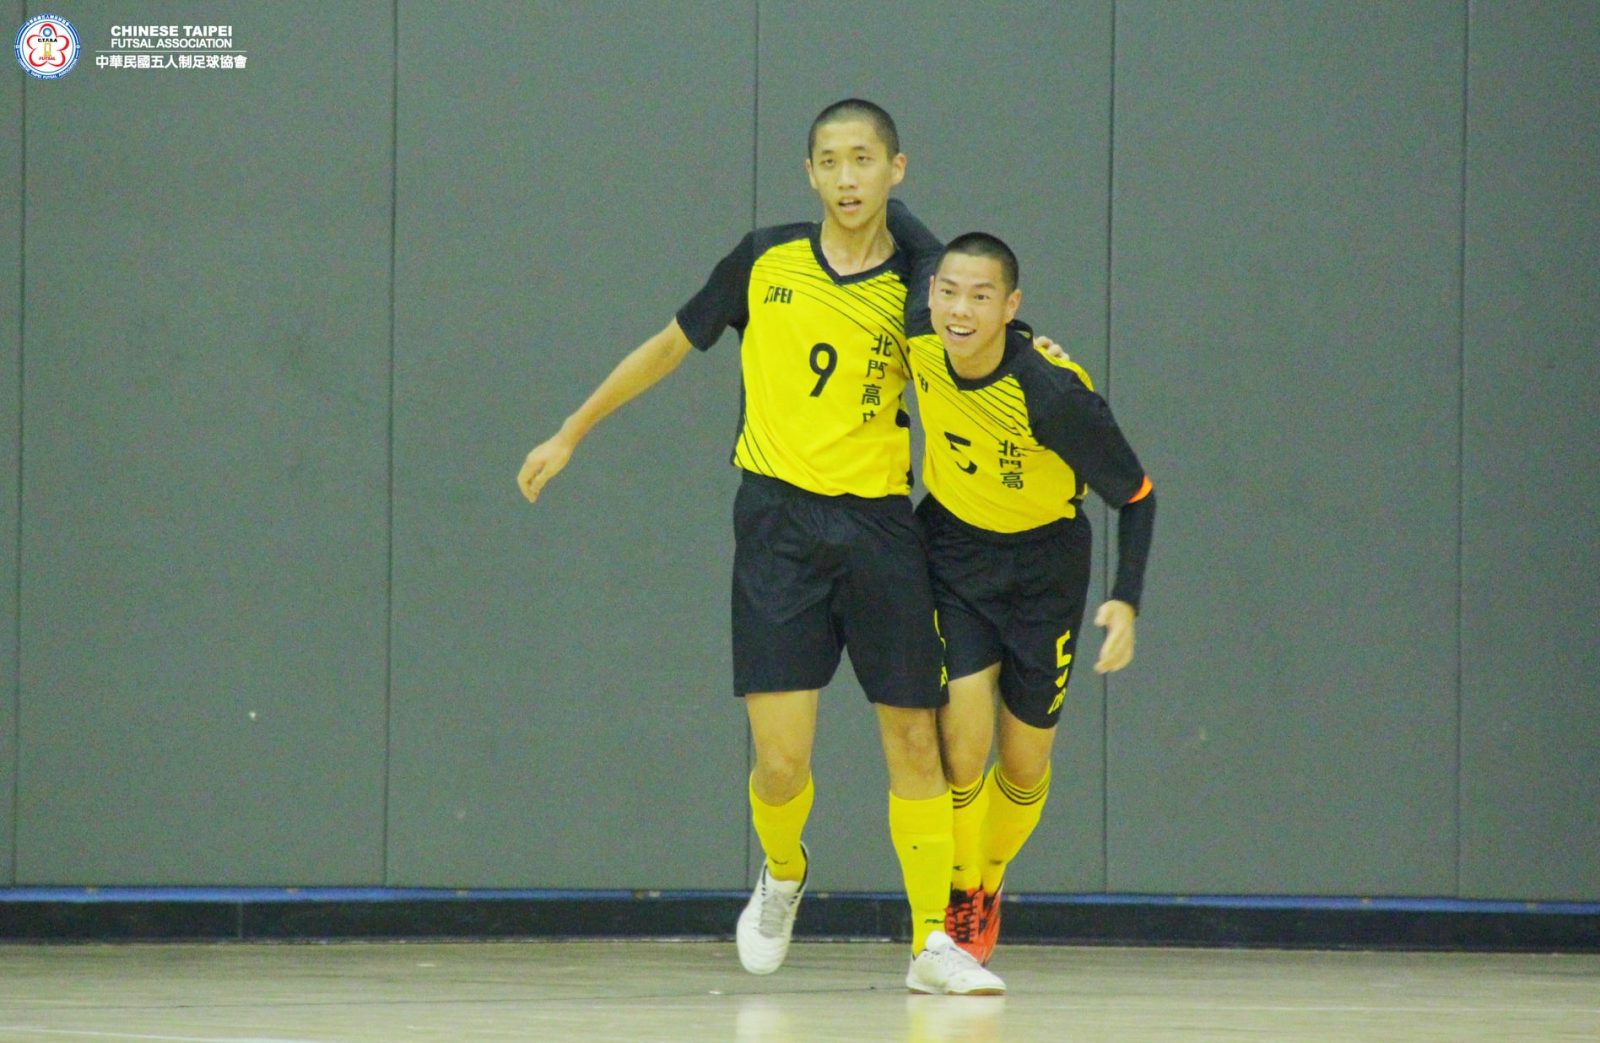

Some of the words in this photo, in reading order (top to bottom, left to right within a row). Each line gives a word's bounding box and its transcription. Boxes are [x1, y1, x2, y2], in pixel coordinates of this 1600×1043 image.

[809, 342, 838, 398] 9
[944, 431, 978, 475] 5
[1055, 629, 1073, 688] 5
